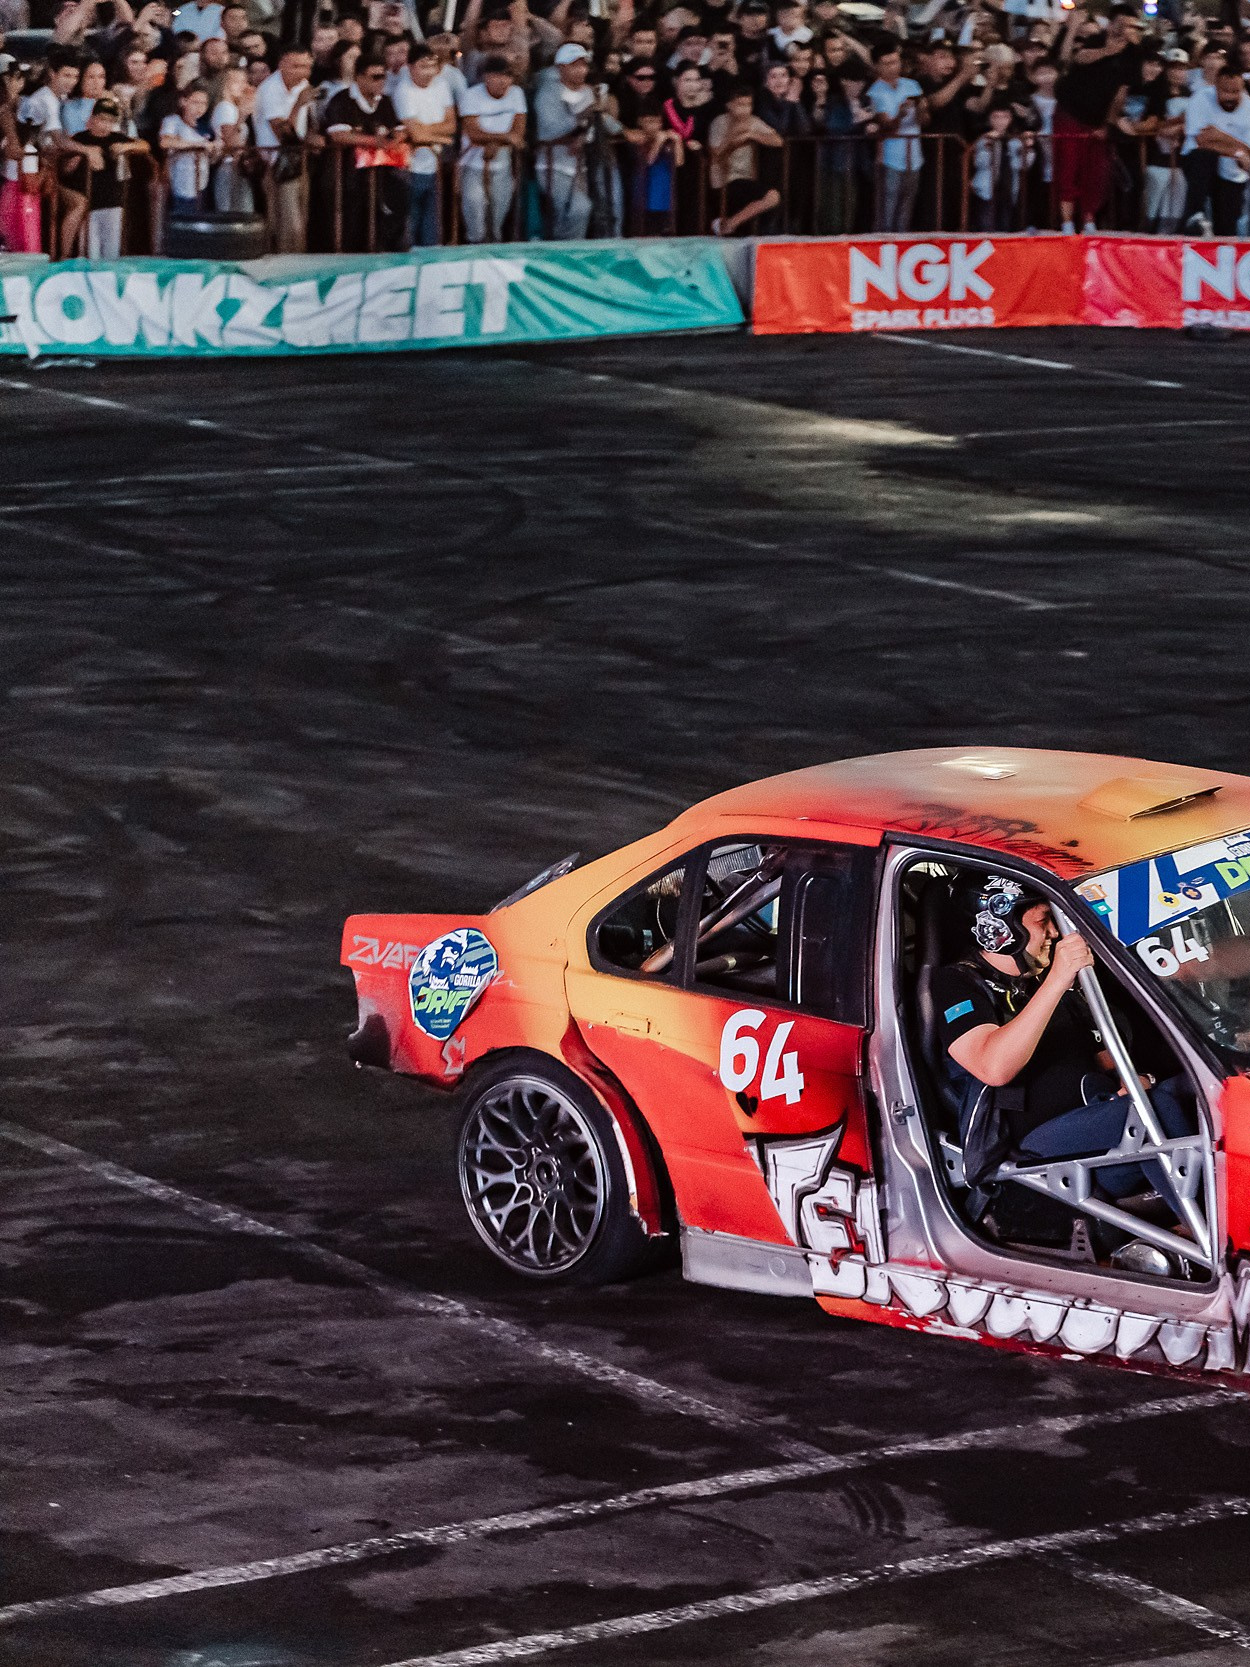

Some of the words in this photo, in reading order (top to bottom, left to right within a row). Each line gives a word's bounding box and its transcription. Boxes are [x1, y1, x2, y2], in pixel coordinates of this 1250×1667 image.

[849, 239, 996, 304] NGK
[852, 308, 920, 330] SPARK
[923, 306, 995, 327] PLUGS
[1136, 926, 1210, 977] 64
[719, 1008, 804, 1106] 64
